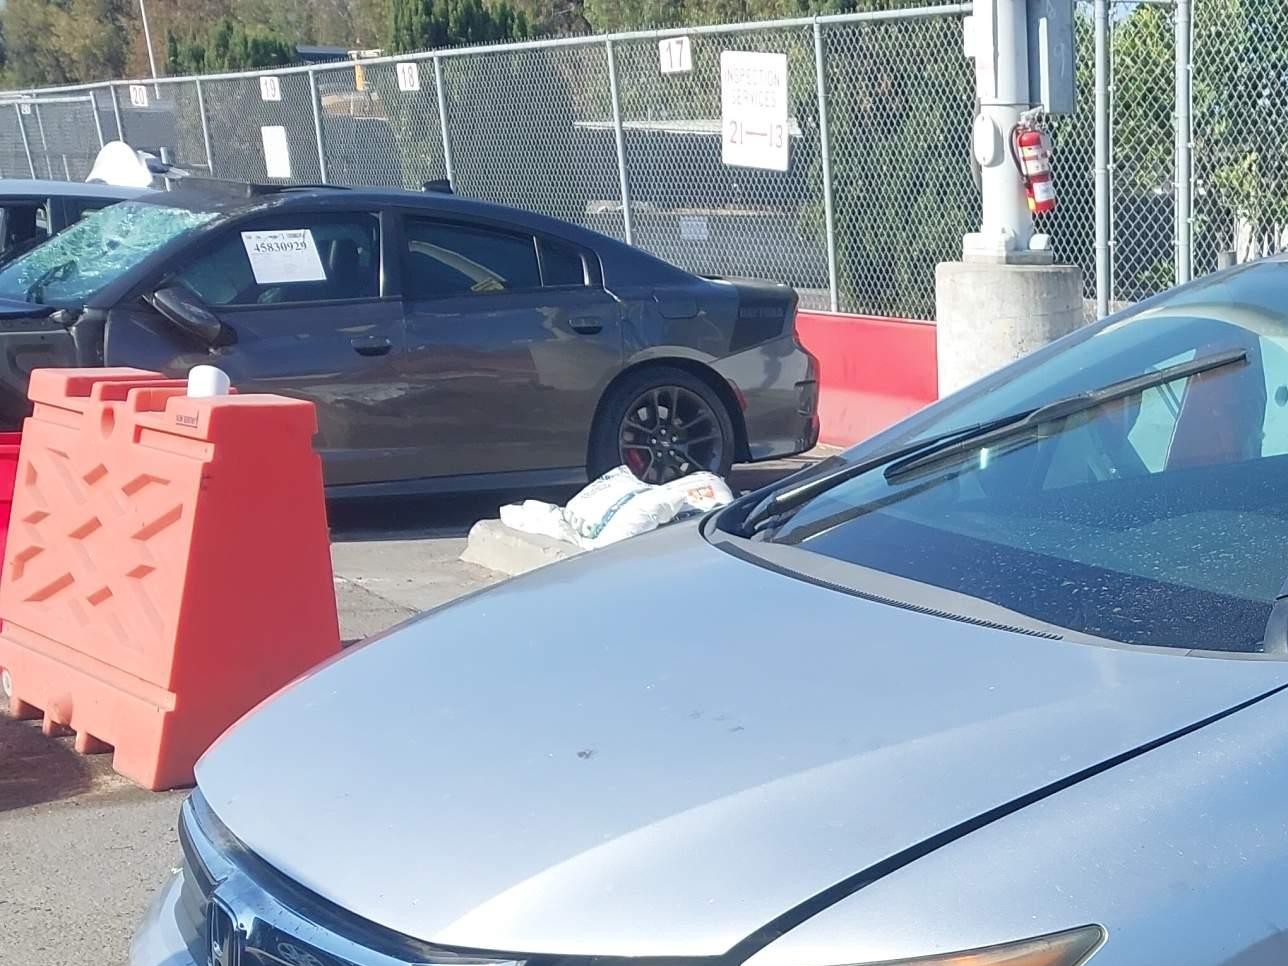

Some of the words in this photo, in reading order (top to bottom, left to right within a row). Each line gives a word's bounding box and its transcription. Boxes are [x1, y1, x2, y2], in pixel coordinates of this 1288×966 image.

[666, 40, 684, 68] 17
[264, 78, 276, 98] 19
[401, 64, 414, 88] 18
